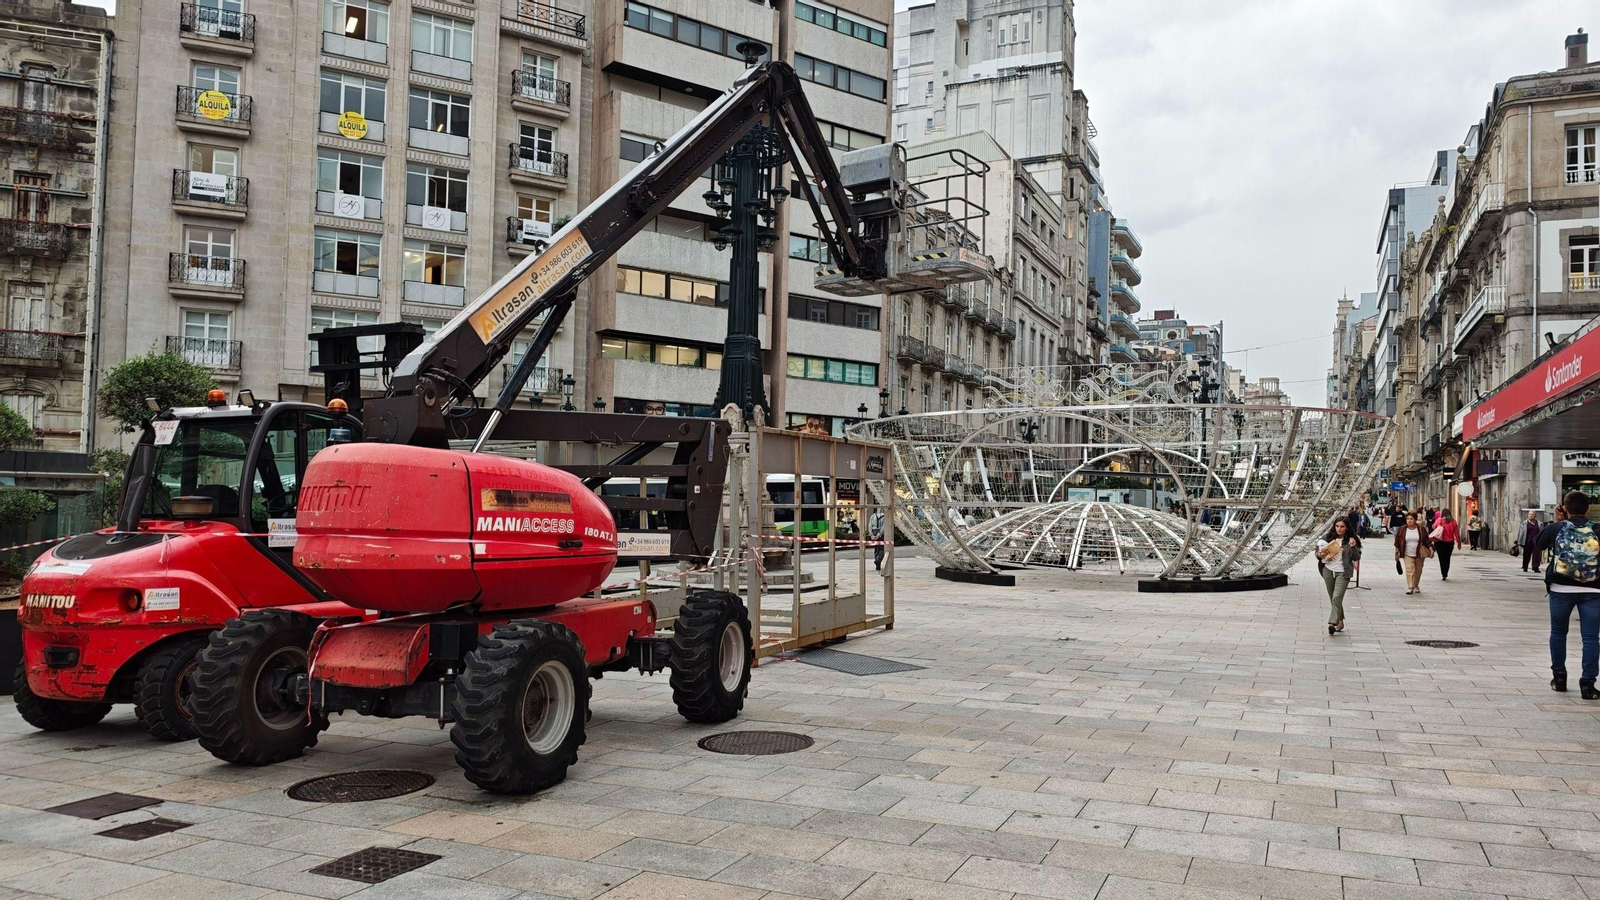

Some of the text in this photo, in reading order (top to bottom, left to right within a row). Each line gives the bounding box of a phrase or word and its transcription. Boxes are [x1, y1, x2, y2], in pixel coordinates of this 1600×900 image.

[199, 100, 229, 110] ALQUILA
[339, 120, 366, 131] ALQUILA
[537, 245, 590, 294] altrasan.com
[481, 286, 534, 341] Altrasan
[539, 265, 550, 277] +34
[549, 255, 561, 269] 986
[560, 245, 573, 259] 603
[572, 236, 584, 249] 619
[1552, 354, 1582, 389] Santander
[1480, 406, 1496, 429] Santander
[1565, 452, 1600, 461] ESTREL
[838, 481, 860, 490] MOVI
[297, 486, 371, 512] ANITOU
[270, 522, 297, 532] Altrasa
[584, 527, 599, 538] 180
[25, 594, 76, 609] MANITOU
